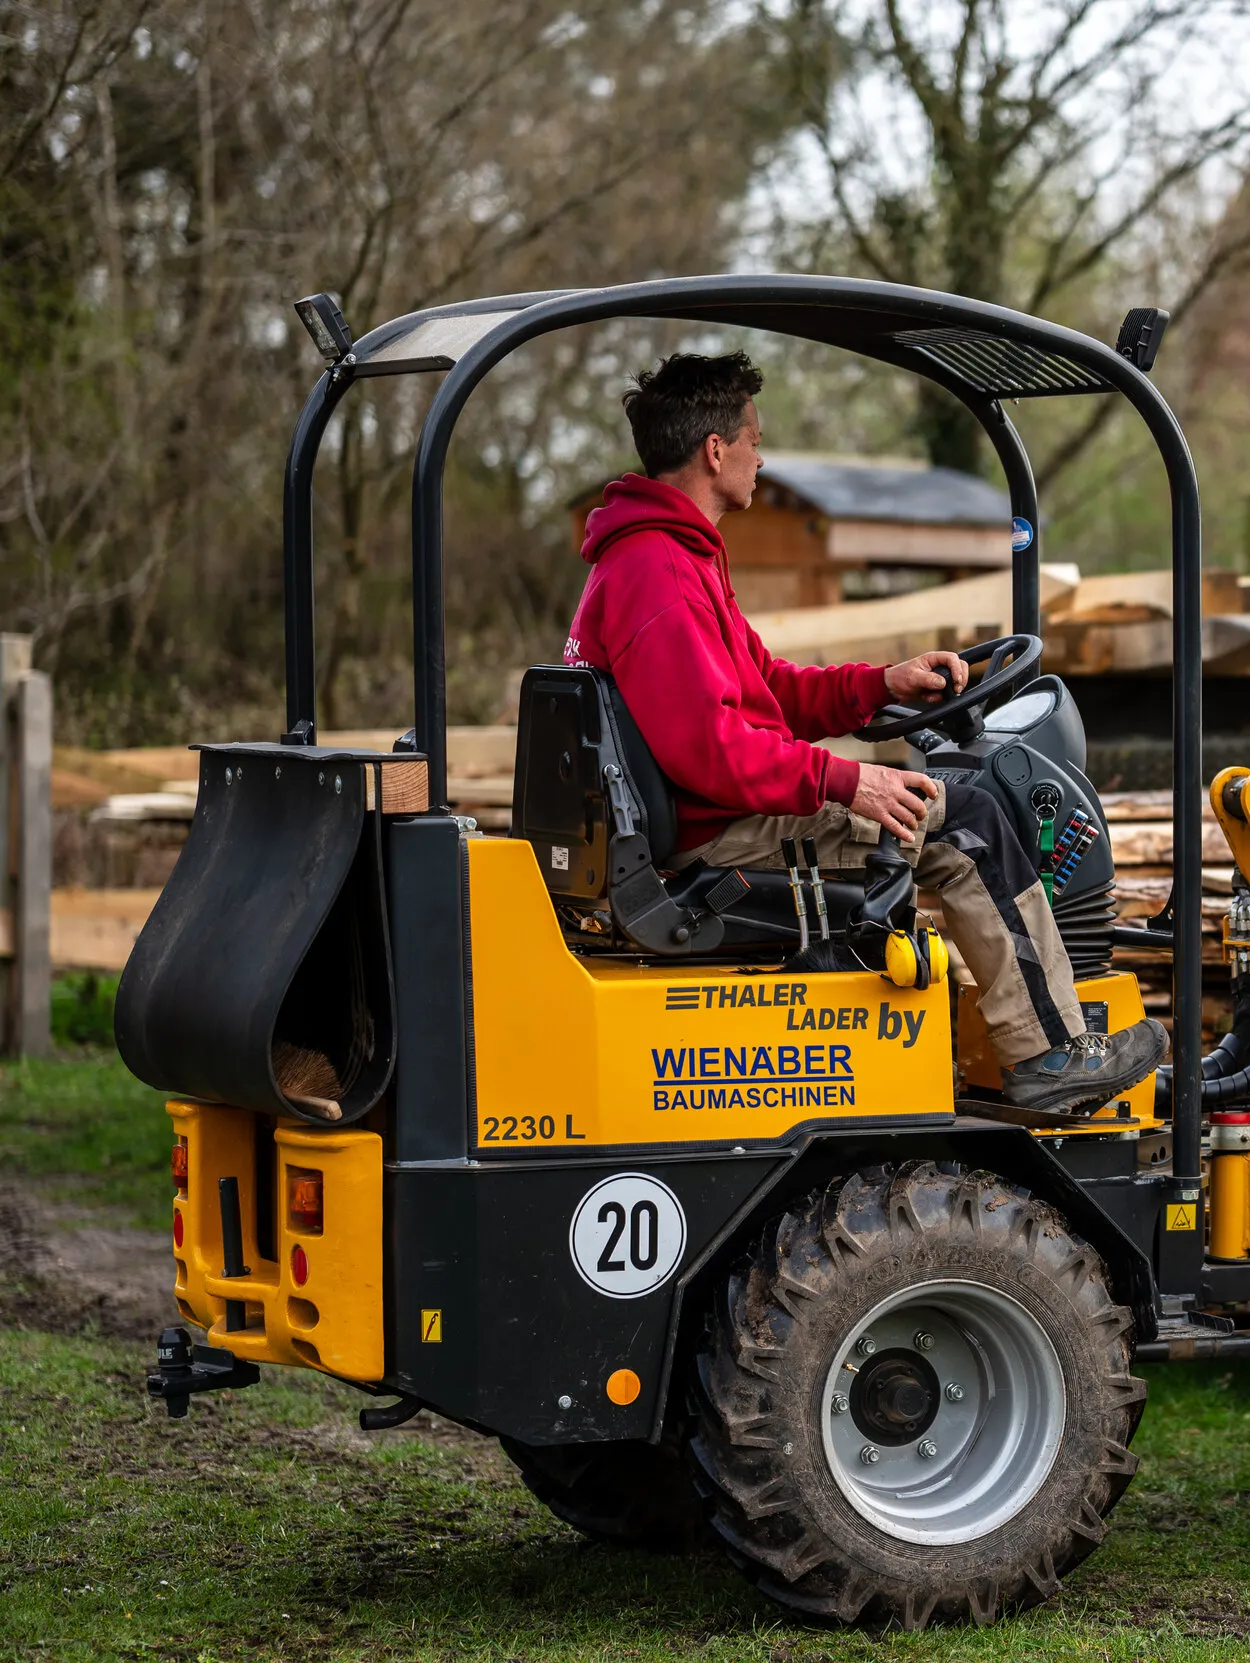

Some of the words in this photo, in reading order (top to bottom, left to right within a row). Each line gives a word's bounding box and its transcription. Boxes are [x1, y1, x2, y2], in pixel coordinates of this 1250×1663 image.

[701, 982, 807, 1008] THALER
[785, 1006, 869, 1031] LADER
[876, 1002, 926, 1049] by
[651, 1044, 854, 1078] WIENÄBER
[652, 1085, 856, 1111] BAUMASCHINEN
[482, 1114, 556, 1142] 2230
[565, 1113, 586, 1140] L
[596, 1199, 660, 1274] 20
